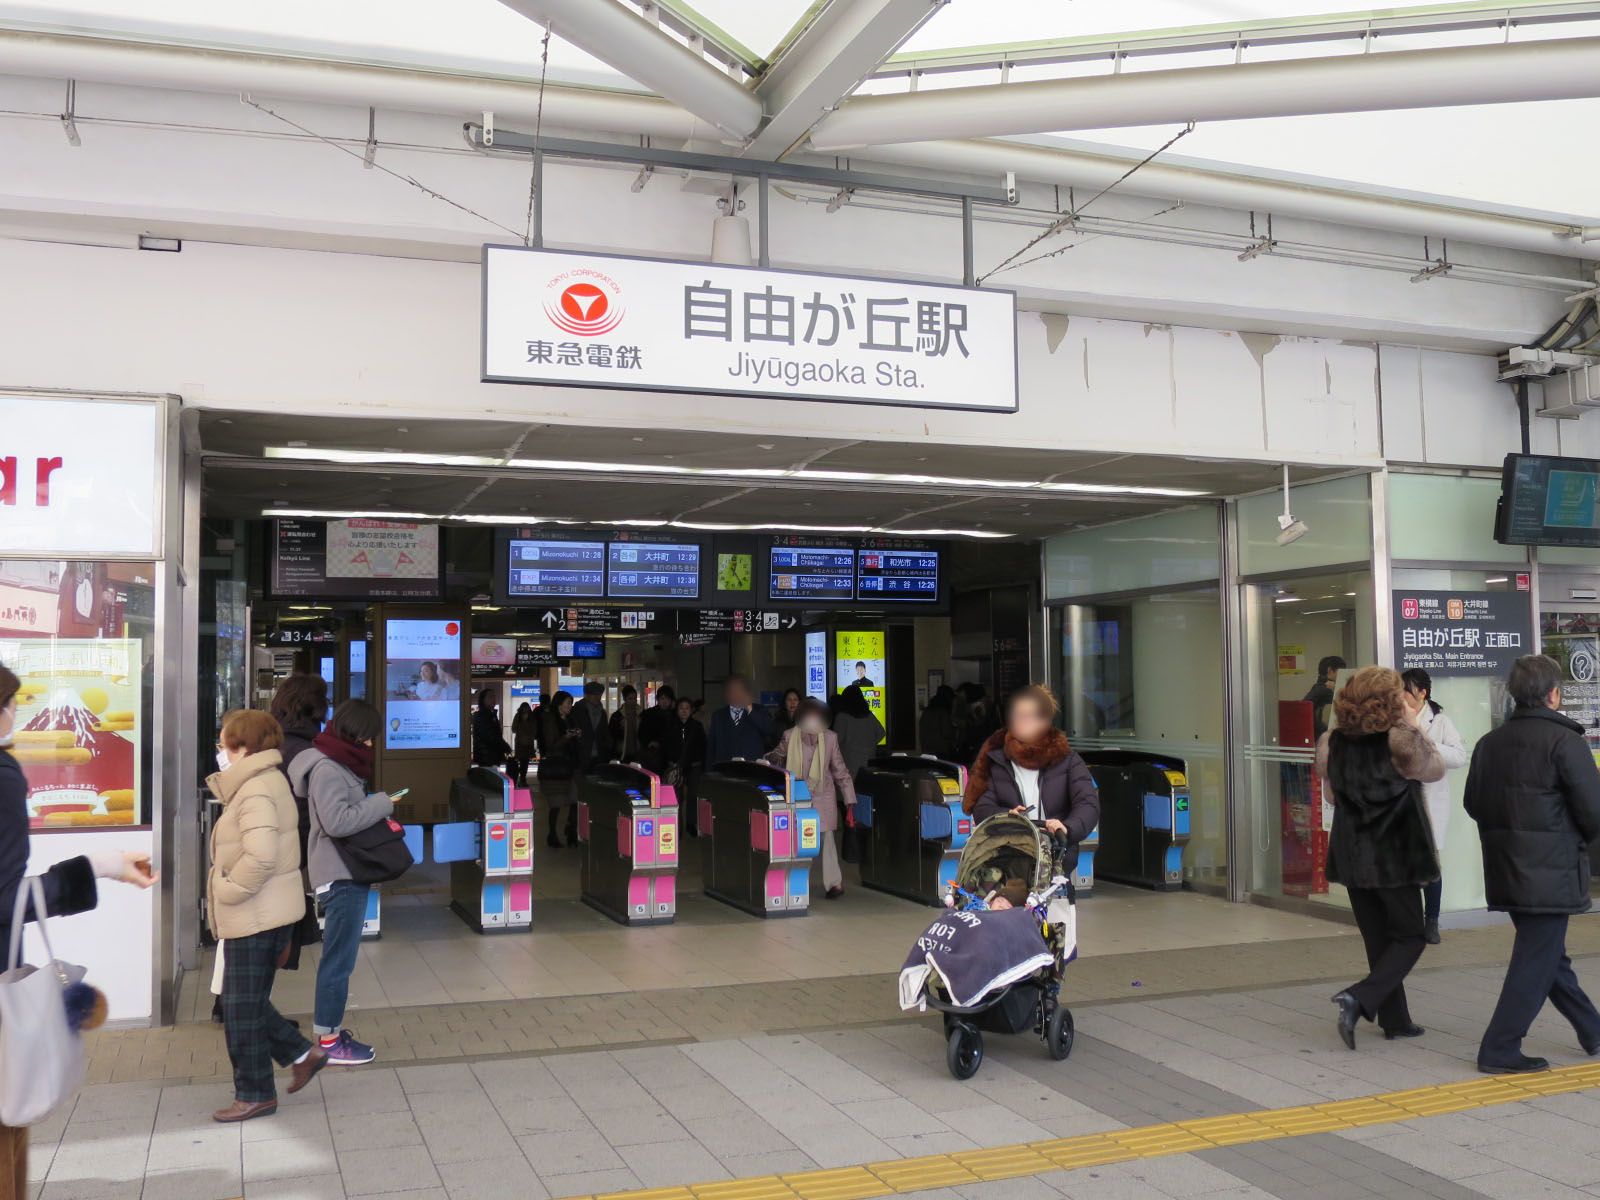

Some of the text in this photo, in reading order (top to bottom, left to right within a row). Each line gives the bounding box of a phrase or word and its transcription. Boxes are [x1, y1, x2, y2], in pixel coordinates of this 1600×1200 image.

[547, 268, 622, 295] TOKYU CORPORATION
[684, 280, 970, 359] 自由が丘駅
[526, 340, 642, 370] 東急電鉄
[728, 352, 925, 388] Jiyūgaoka Sta.
[541, 550, 578, 559] Mizonokuchi
[644, 552, 669, 562] 大井町
[834, 556, 852, 565] 12:26
[889, 558, 912, 567] 和光市
[918, 559, 936, 567] 12:25
[541, 574, 578, 583] Mizonokuchi
[581, 575, 601, 583] 12:34
[620, 575, 636, 584] 各停
[644, 575, 669, 585] 大井町
[834, 579, 852, 587] 12:33
[865, 580, 878, 588] 各停
[917, 581, 936, 589] 12:26
[1419, 599, 1439, 608] 東横線
[1463, 600, 1489, 609] 大井町線
[1404, 608, 1415, 617] 07
[1450, 608, 1461, 617] 10
[559, 620, 566, 631] 2
[1402, 627, 1521, 648] 自由が丘駅 正面口
[1403, 661, 1424, 669] 自由丘站
[774, 816, 788, 831] IC
[637, 821, 653, 836] IC
[774, 897, 780, 905] 6
[794, 896, 800, 904] 7
[660, 904, 666, 912] 6
[491, 914, 498, 922] 4
[515, 912, 521, 920] 5
